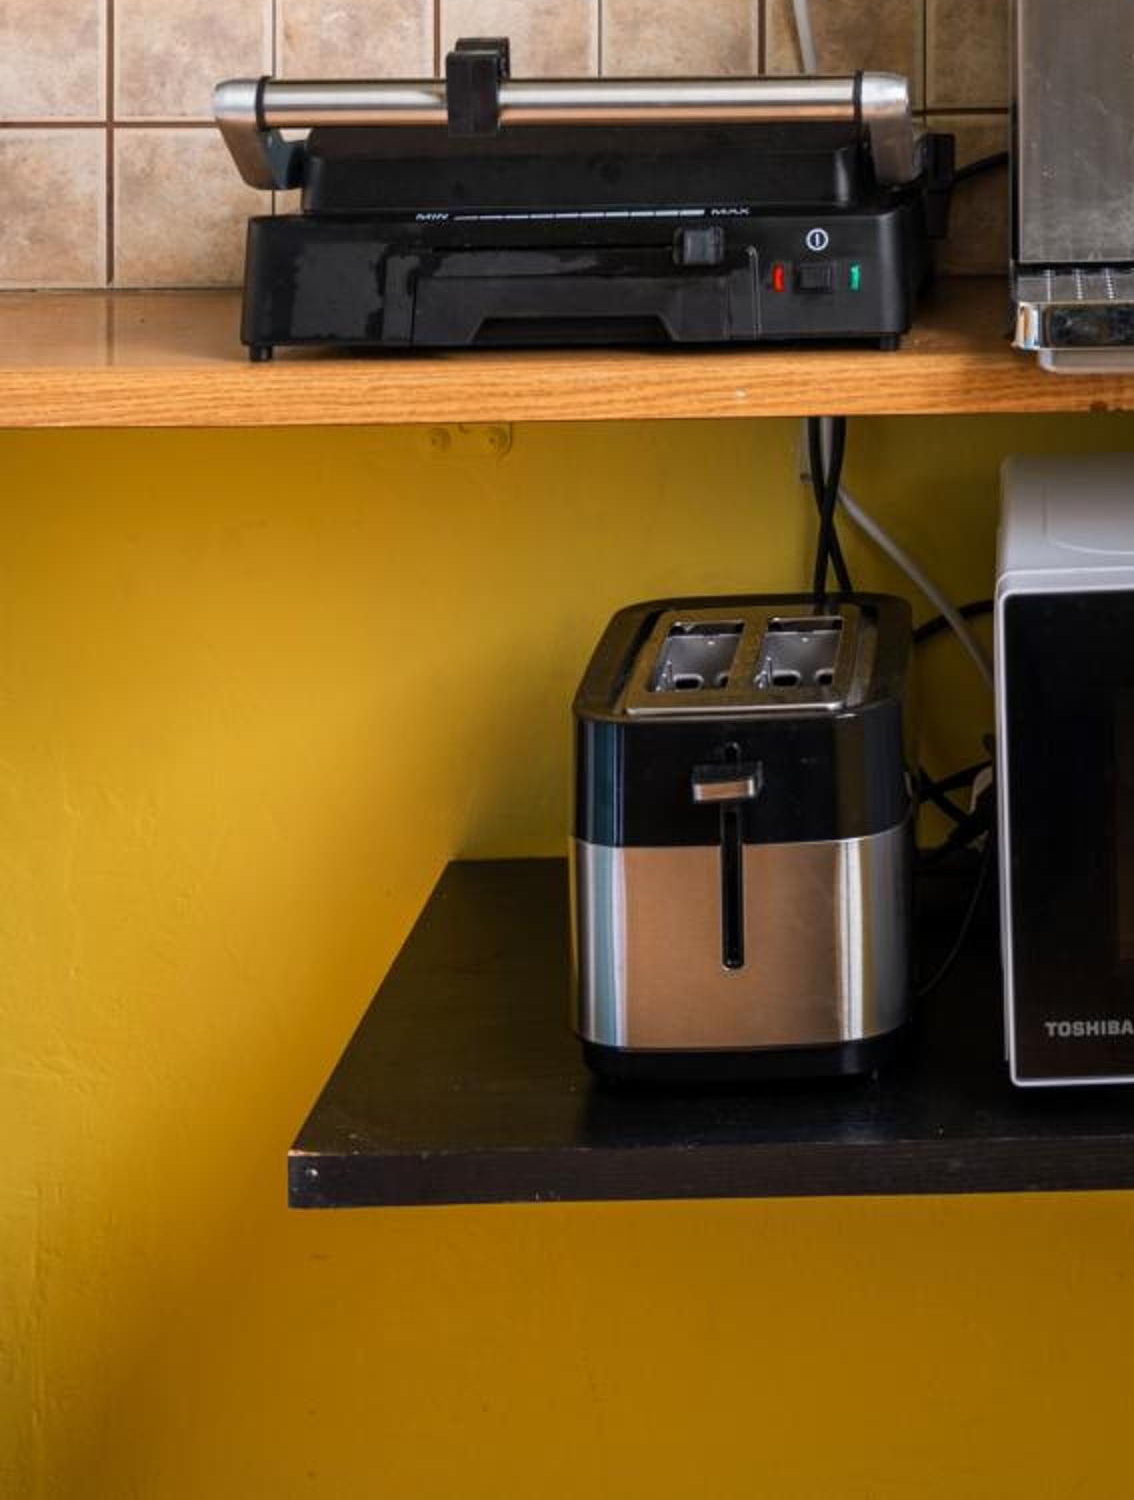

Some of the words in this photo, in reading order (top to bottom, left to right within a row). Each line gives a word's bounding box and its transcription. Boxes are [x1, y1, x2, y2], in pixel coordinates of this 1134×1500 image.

[416, 212, 449, 221] MIN
[711, 207, 750, 216] MAX
[1044, 1019, 1134, 1038] TOSHIBA
